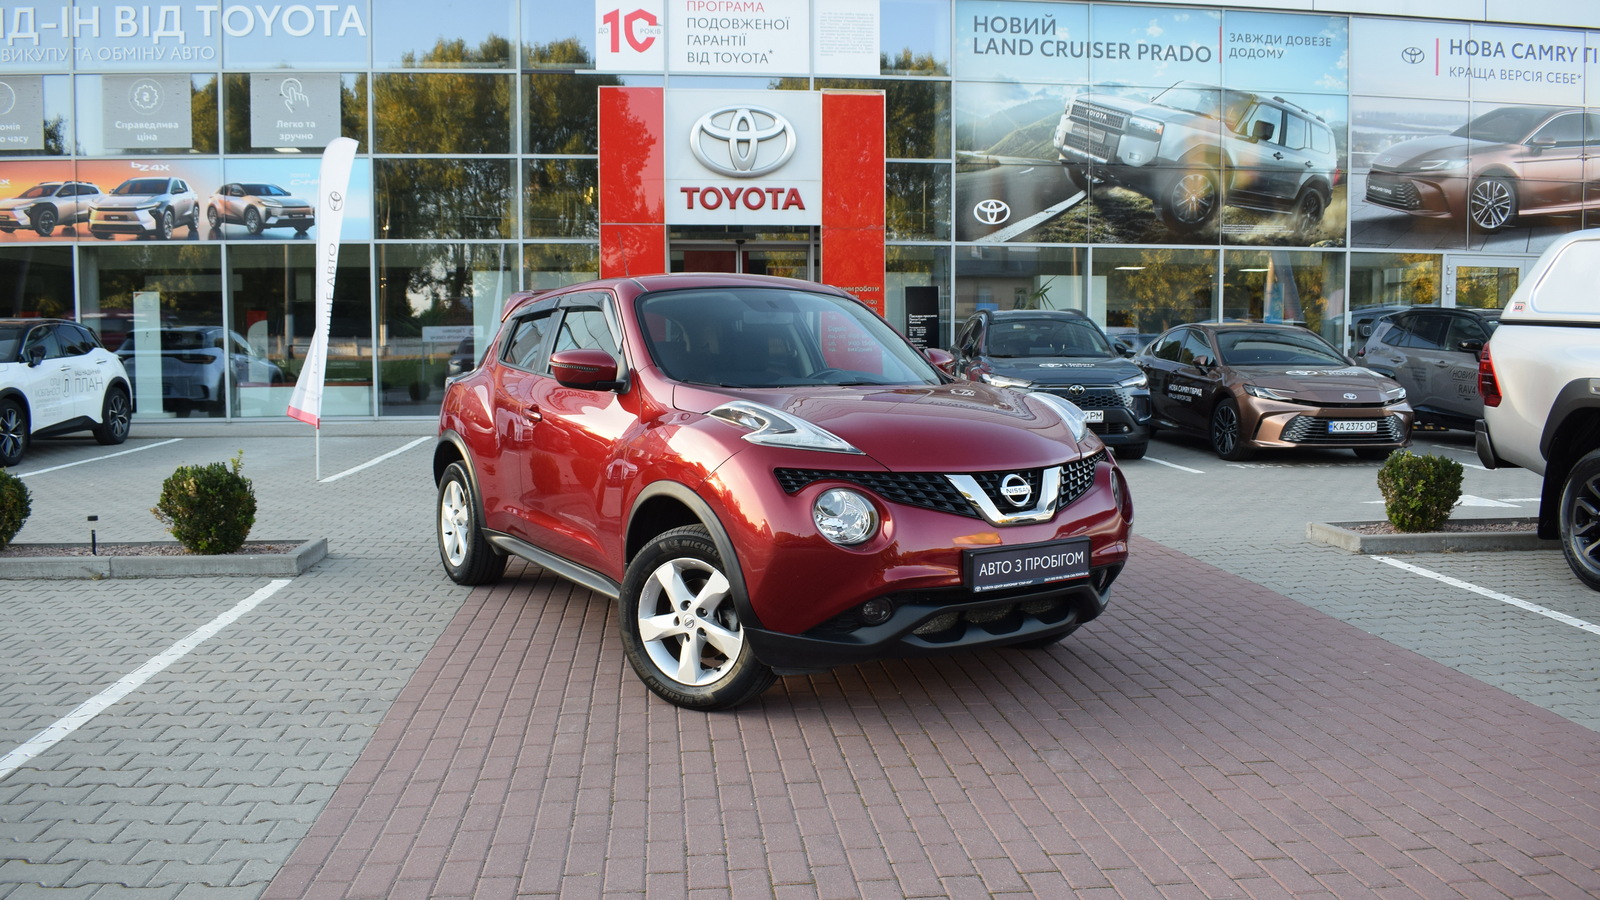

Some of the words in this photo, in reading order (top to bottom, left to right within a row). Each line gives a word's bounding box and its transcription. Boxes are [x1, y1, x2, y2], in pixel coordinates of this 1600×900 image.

[687, 0, 765, 12] ПРОГРАМА
[0, 6, 100, 46] Д-ІН
[115, 5, 186, 44] ВІД
[195, 5, 367, 37] TOYOTA
[686, 17, 790, 31] ПОДОВЖЕНОЇ
[973, 13, 1057, 37] НОВИЙ
[686, 33, 747, 47] ГАРАНТІЇ
[1228, 32, 1283, 47] ЗАВЖДИ
[1285, 34, 1333, 48] ДОВЕЗЕ
[1, 47, 69, 63] ВИКУПУ
[74, 47, 95, 62] ТА
[97, 46, 166, 62] ОБМІНУ
[168, 46, 216, 61] АВТО
[973, 37, 1034, 57] LAND
[1039, 39, 1132, 61] CRUISER
[1137, 44, 1212, 63] PRADO
[1228, 47, 1285, 60] ДОДОМУ
[1449, 38, 1506, 59] НОВА
[1511, 42, 1578, 63] CAMRY
[686, 52, 710, 65] ВІД
[1449, 66, 1497, 81] КРАЩА
[1500, 68, 1543, 82] ВЕРСІЯ
[115, 121, 180, 132] Справедлива
[275, 120, 303, 130] Легко
[304, 121, 316, 130] та
[136, 132, 158, 143] ціна
[279, 133, 314, 142] зручно
[680, 187, 806, 211] TOYOTA
[1458, 383, 1476, 395] RAV4
[1333, 421, 1345, 431] KA
[1345, 421, 1364, 431] 2375
[1365, 421, 1376, 431] OP
[681, 540, 719, 557] MICHEL
[978, 560, 1013, 577] АВТО
[1014, 558, 1023, 573] З
[1025, 550, 1085, 572] ПРОБІГОМ
